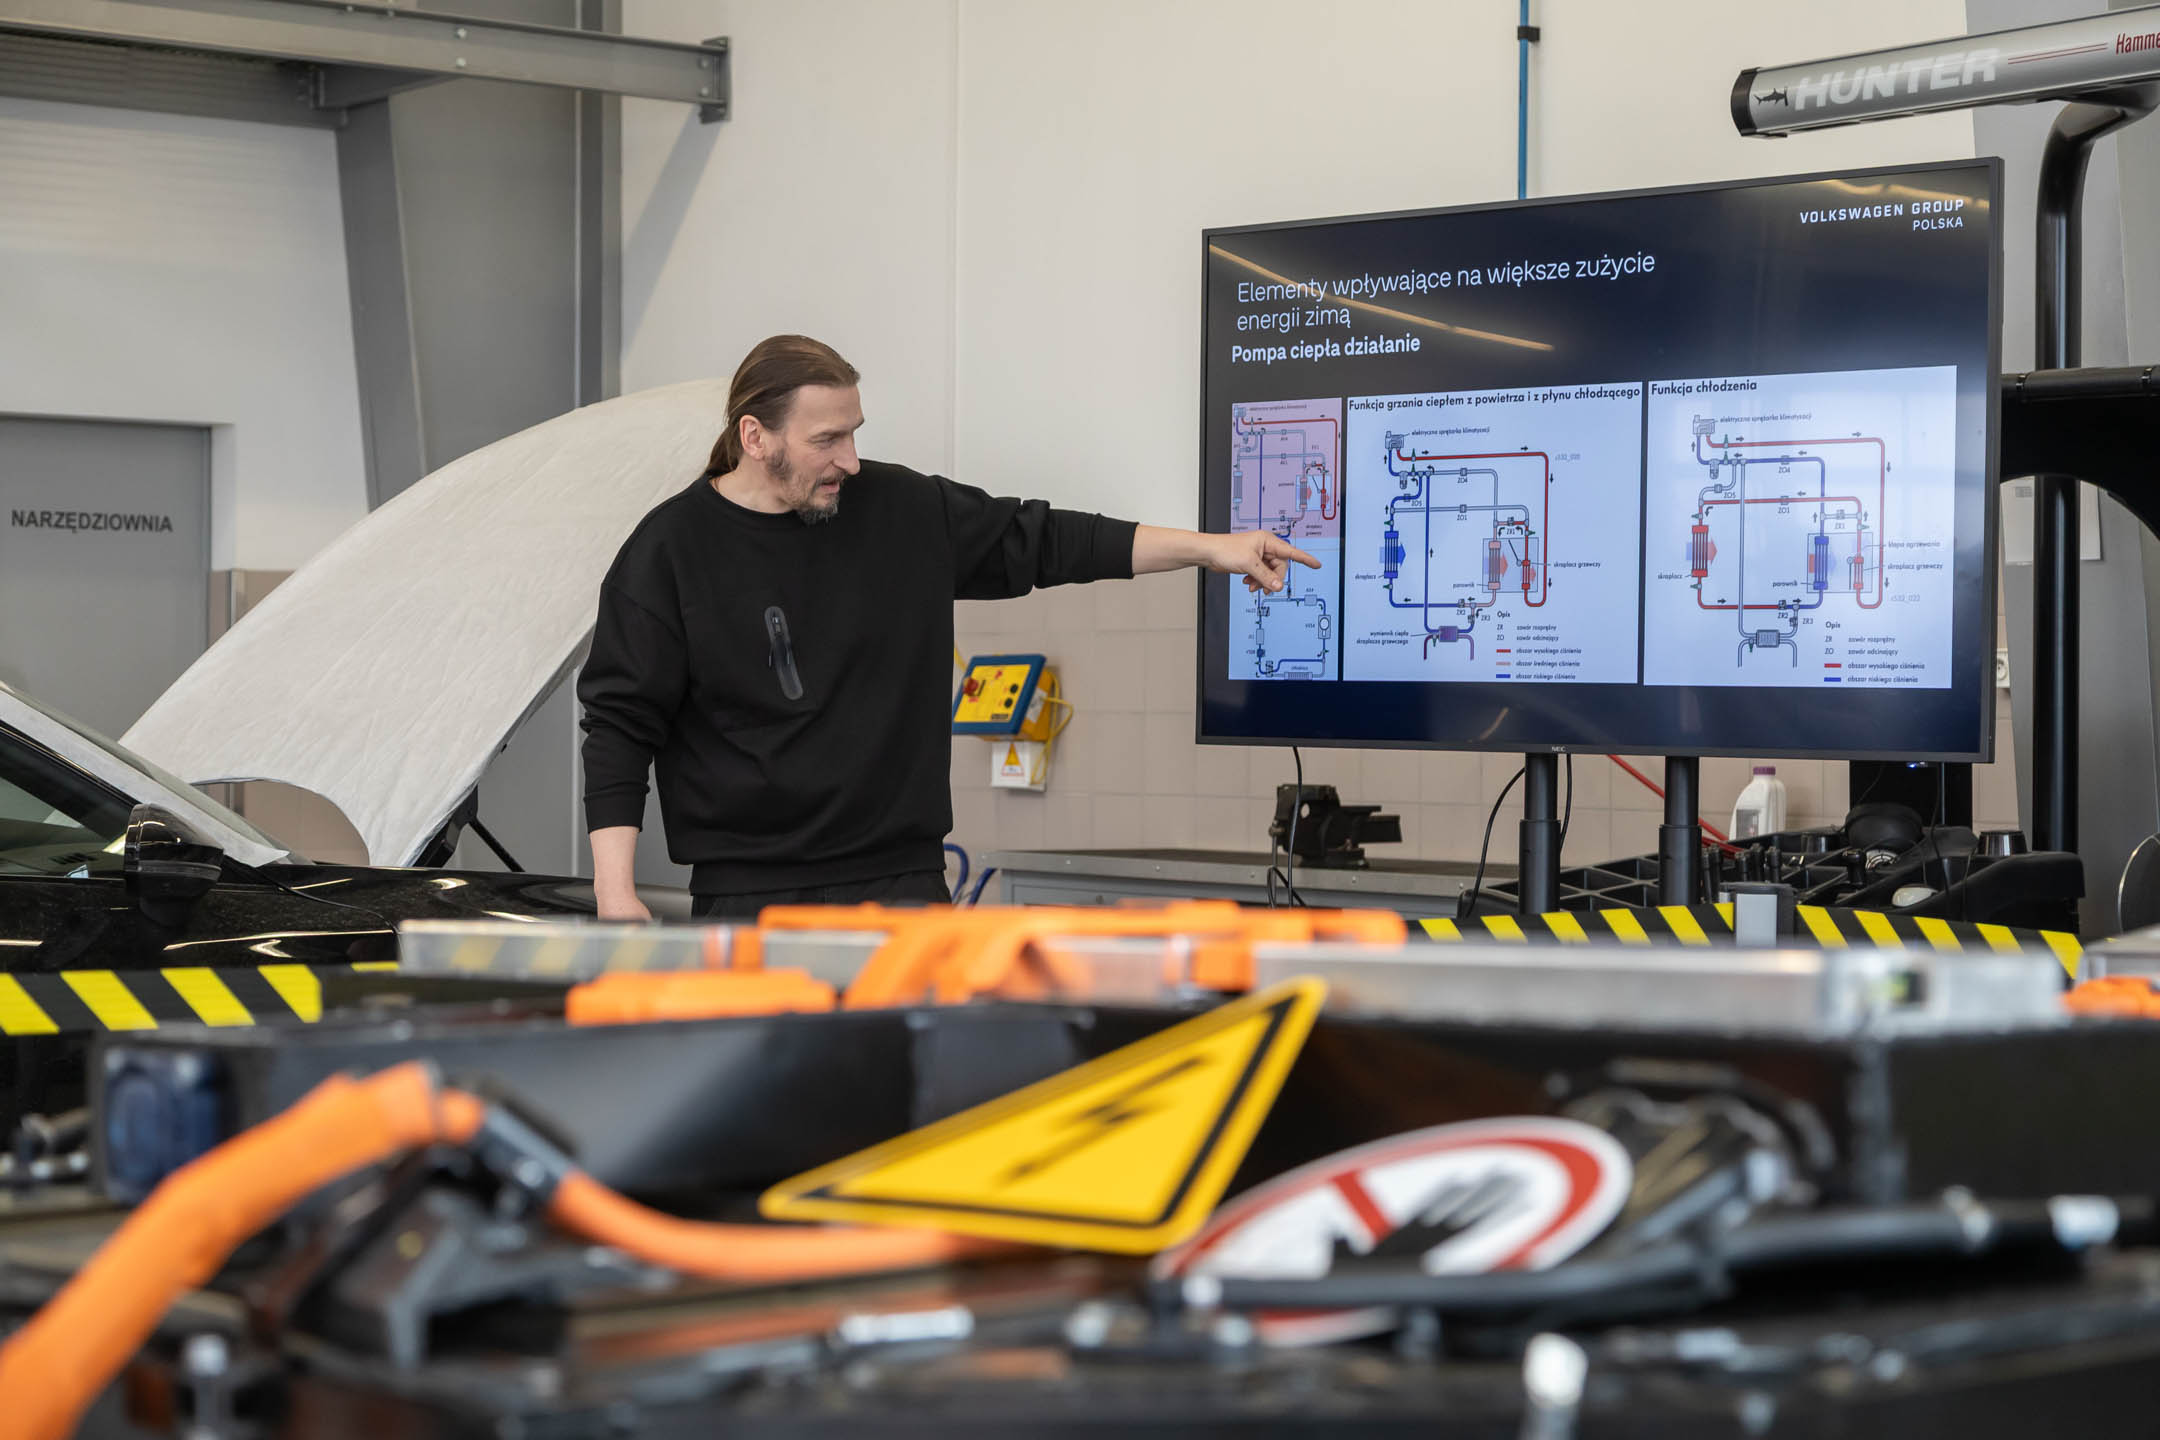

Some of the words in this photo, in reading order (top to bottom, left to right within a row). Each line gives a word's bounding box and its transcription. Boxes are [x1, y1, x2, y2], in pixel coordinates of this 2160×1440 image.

[1794, 47, 1999, 111] HUNTER
[1800, 204, 1904, 224] VOLKSWAGEN
[1911, 199, 1964, 215] GROUP
[1913, 216, 1964, 231] POLSKA
[1238, 278, 1328, 302] Elementy
[1332, 269, 1452, 299] wpływające
[1457, 268, 1482, 287] na
[1487, 259, 1570, 288] większe
[1575, 251, 1656, 281] zużycie
[1237, 307, 1300, 333] energii
[1305, 305, 1351, 328] zimą
[1231, 344, 1287, 365] Pompa
[1290, 338, 1341, 362] ciepła
[1344, 333, 1421, 357] działanie
[1349, 400, 1385, 412] Funkcja
[1387, 397, 1423, 411] grzania
[1425, 395, 1464, 410] ciepłem
[1467, 397, 1473, 405] z
[1475, 393, 1525, 407] powietrza
[1542, 389, 1571, 403] płynu
[1574, 386, 1641, 400] chłodzącego
[1651, 382, 1693, 396] Funkcja
[1696, 379, 1758, 393] chłodzenia
[11, 508, 174, 534] NARZĘDZIOWNIA
[1497, 610, 1511, 619] Opis
[1825, 621, 1841, 630] Opis
